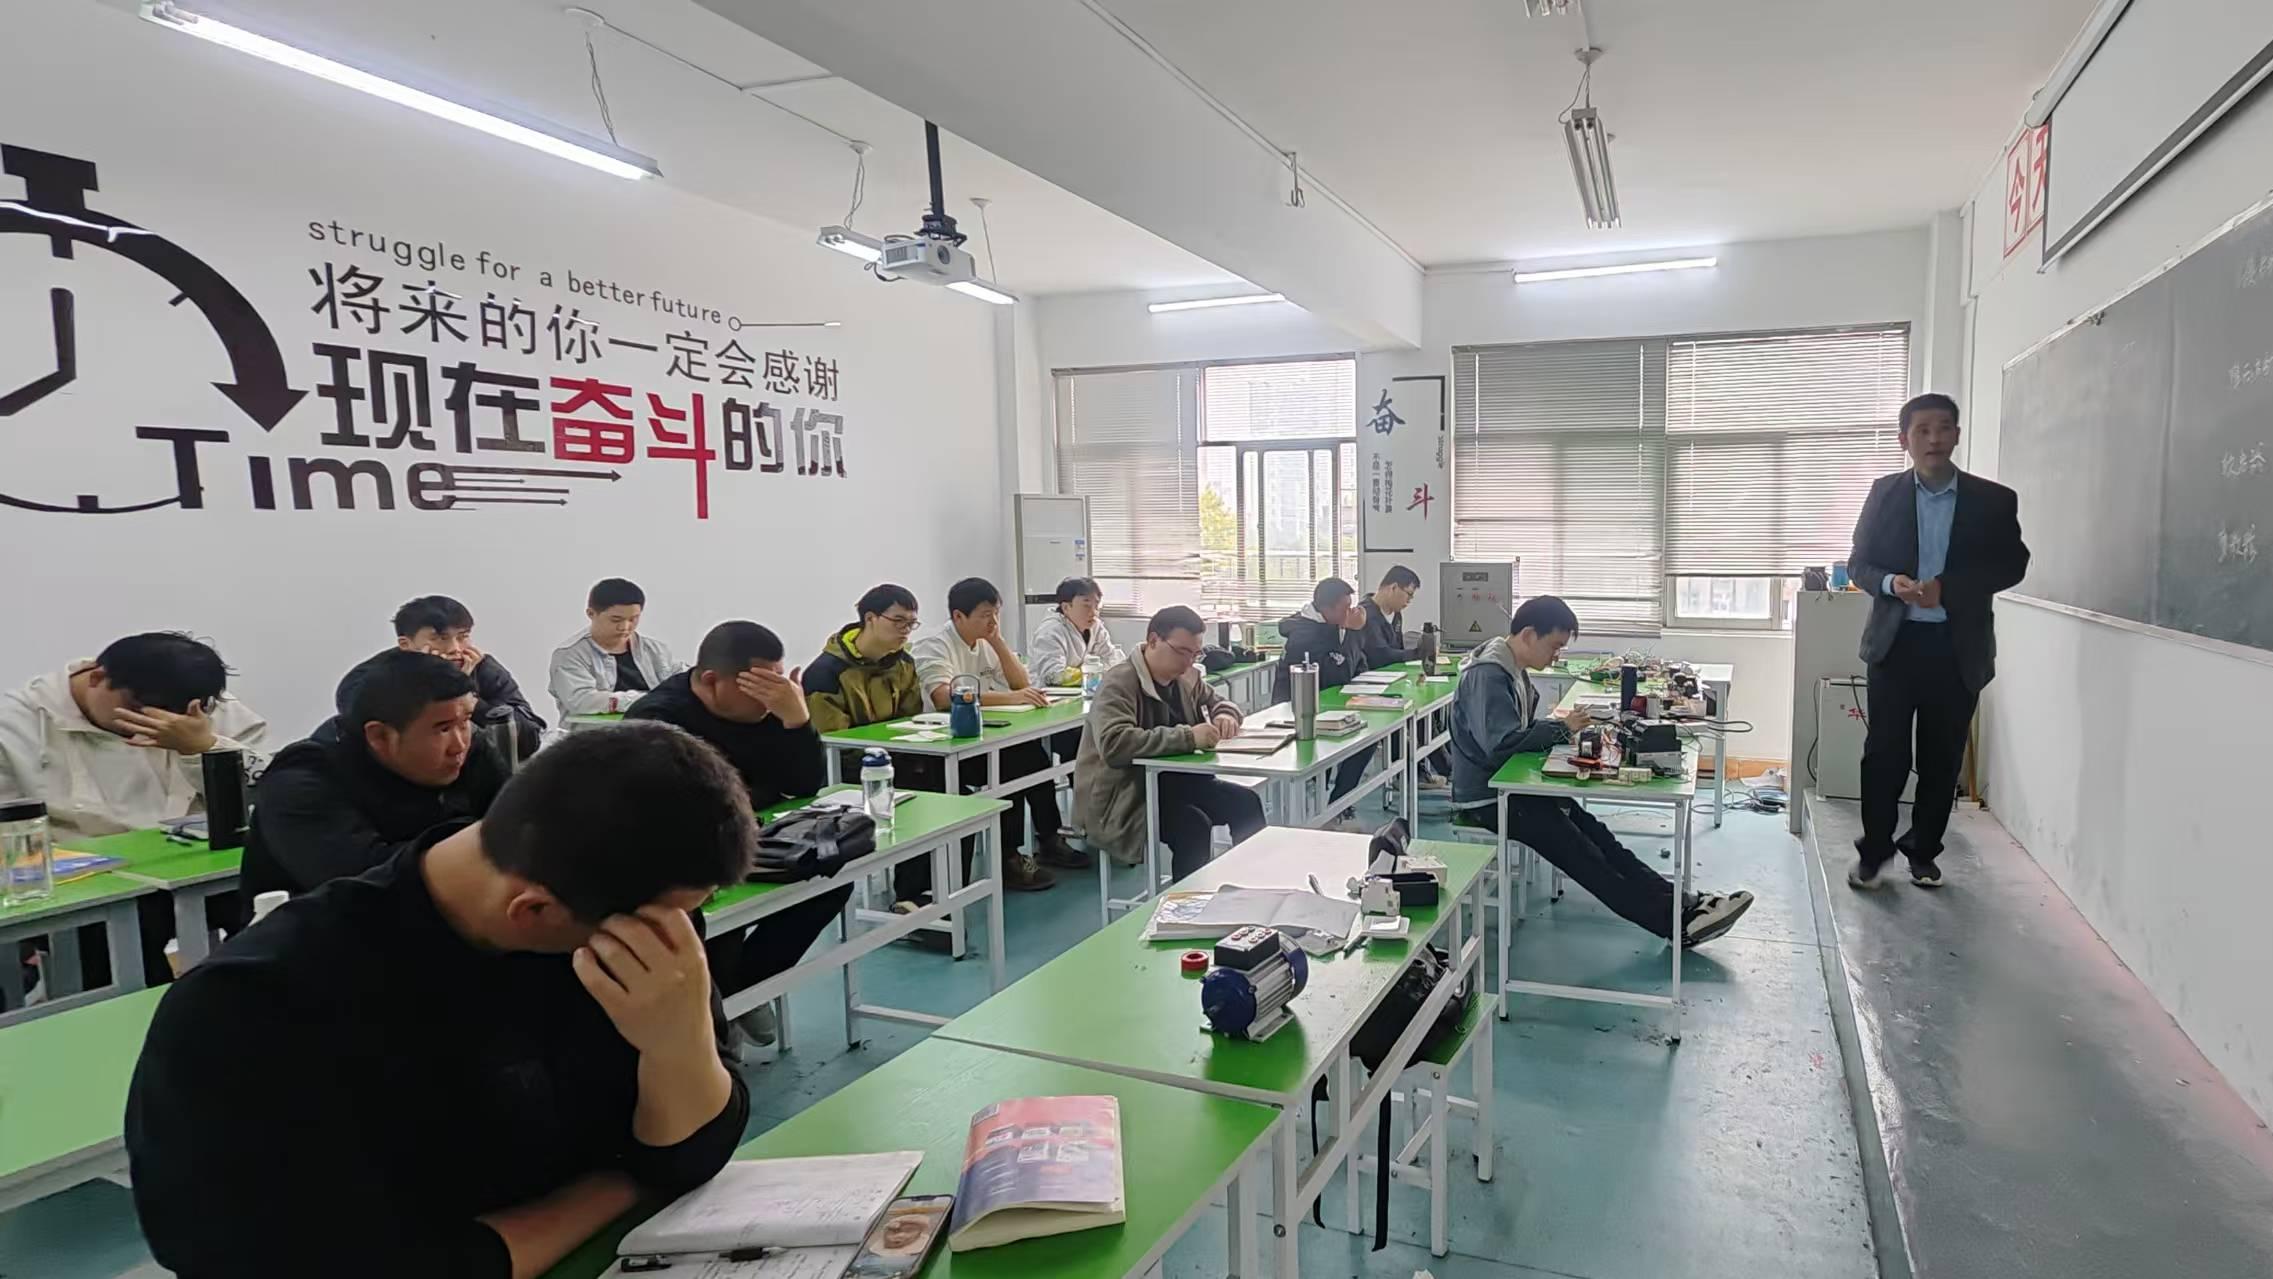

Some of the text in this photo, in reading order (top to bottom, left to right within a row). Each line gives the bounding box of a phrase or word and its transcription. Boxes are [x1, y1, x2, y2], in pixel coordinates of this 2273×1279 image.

[308, 219, 721, 324] struggle for a better future
[308, 261, 840, 402] 将来的你一定会感谢
[311, 342, 848, 520] 现在奋斗的你
[1366, 388, 1406, 436] 奋
[1406, 482, 1435, 521] 斗
